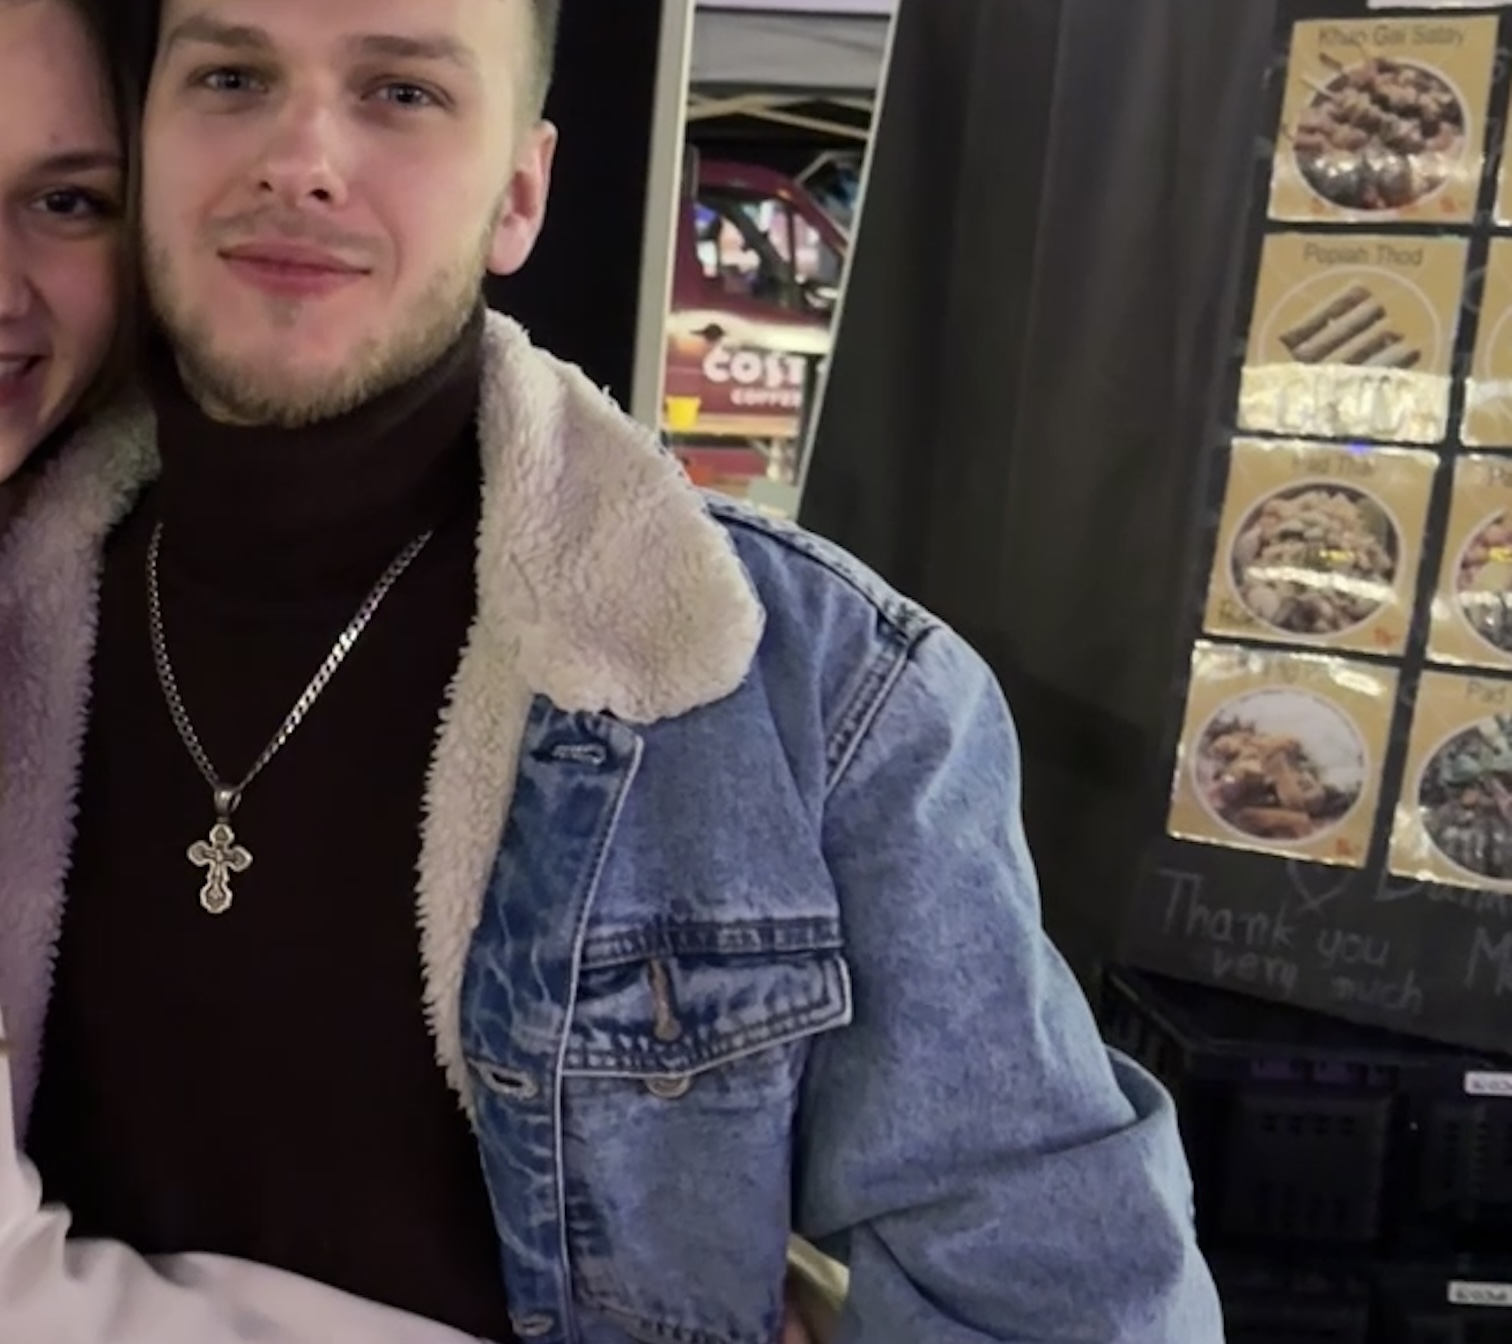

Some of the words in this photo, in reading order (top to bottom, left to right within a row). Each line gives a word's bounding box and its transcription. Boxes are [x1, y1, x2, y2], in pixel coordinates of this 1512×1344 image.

[1154, 867, 1296, 952] Thank
[1317, 927, 1390, 970] you
[1211, 945, 1299, 998] very
